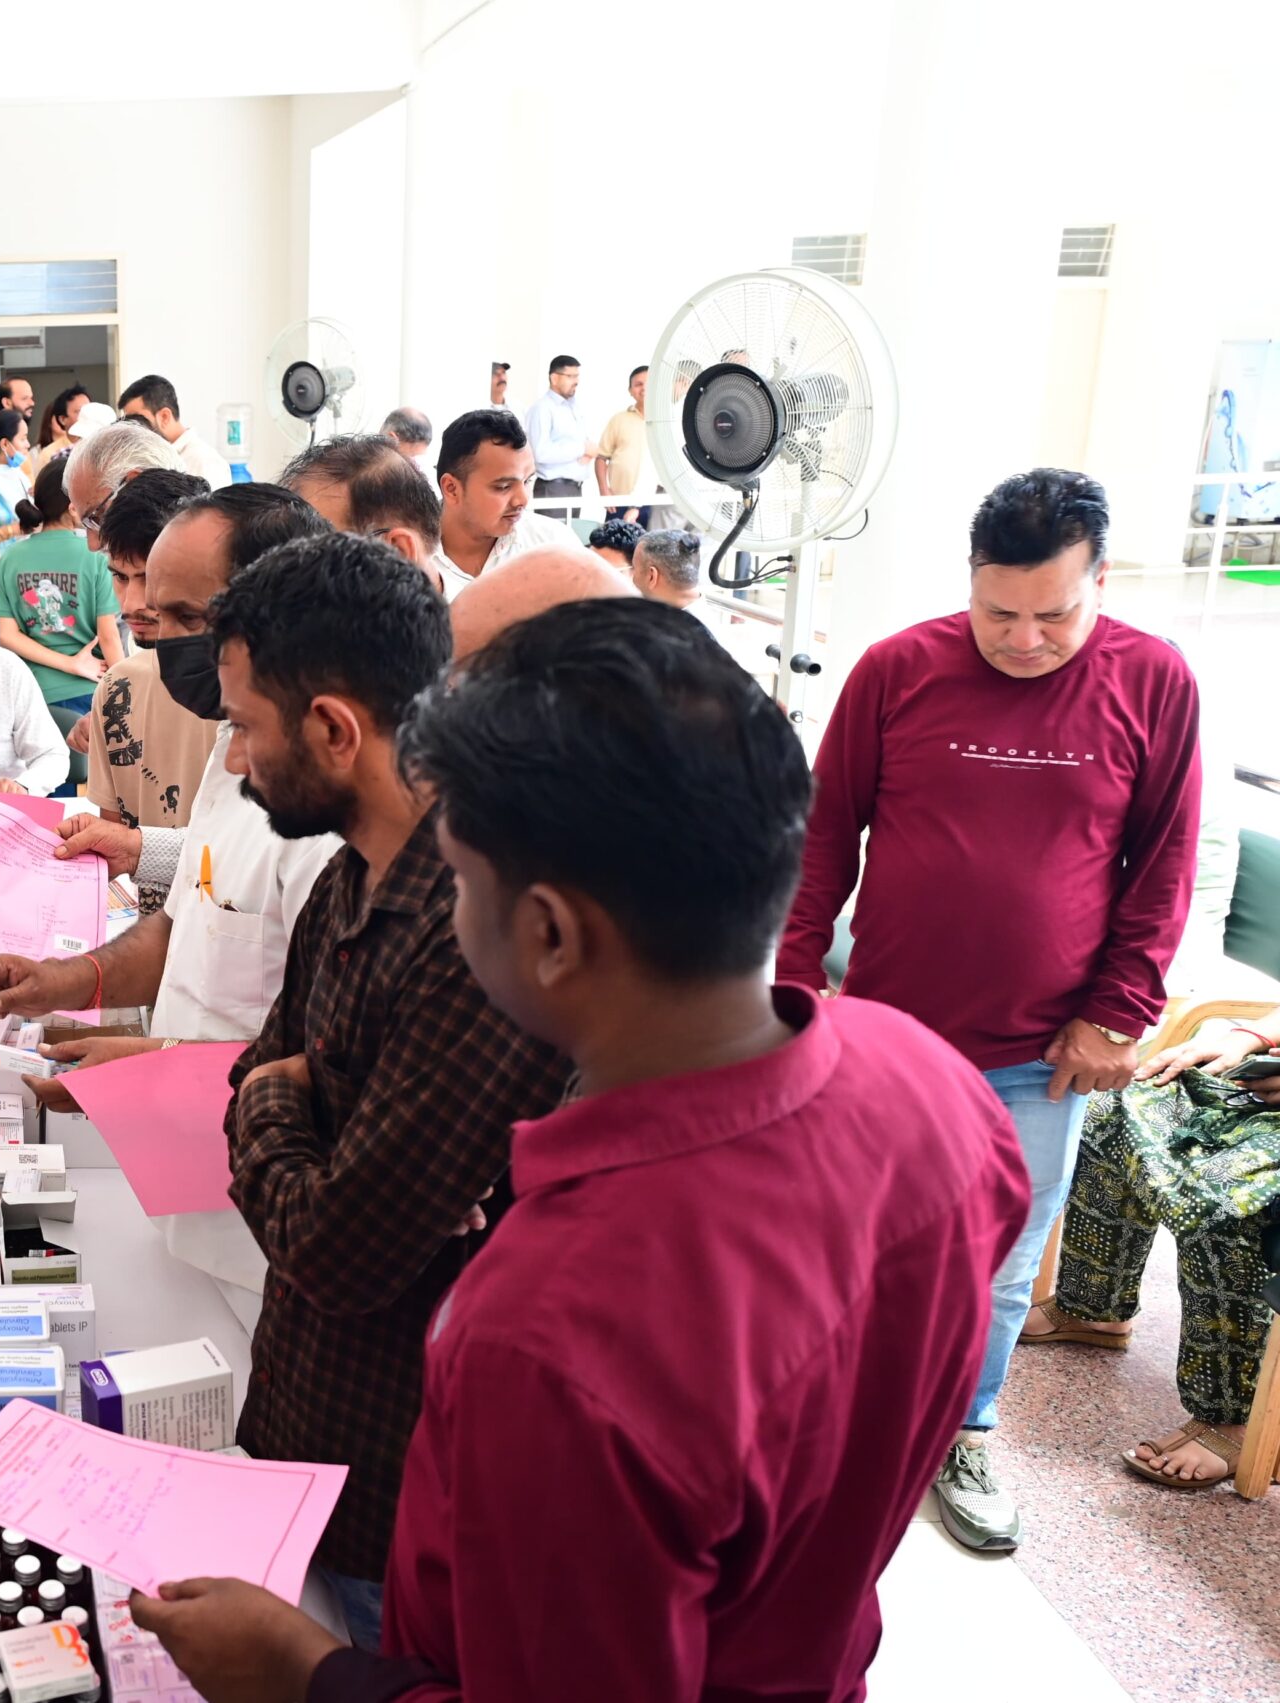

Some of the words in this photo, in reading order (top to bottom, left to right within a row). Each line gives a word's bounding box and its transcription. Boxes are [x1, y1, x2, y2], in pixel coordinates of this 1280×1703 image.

[949, 743, 1095, 761] BROOKLYN
[50, 1322, 76, 1333] ablets
[79, 1322, 88, 1331] IP
